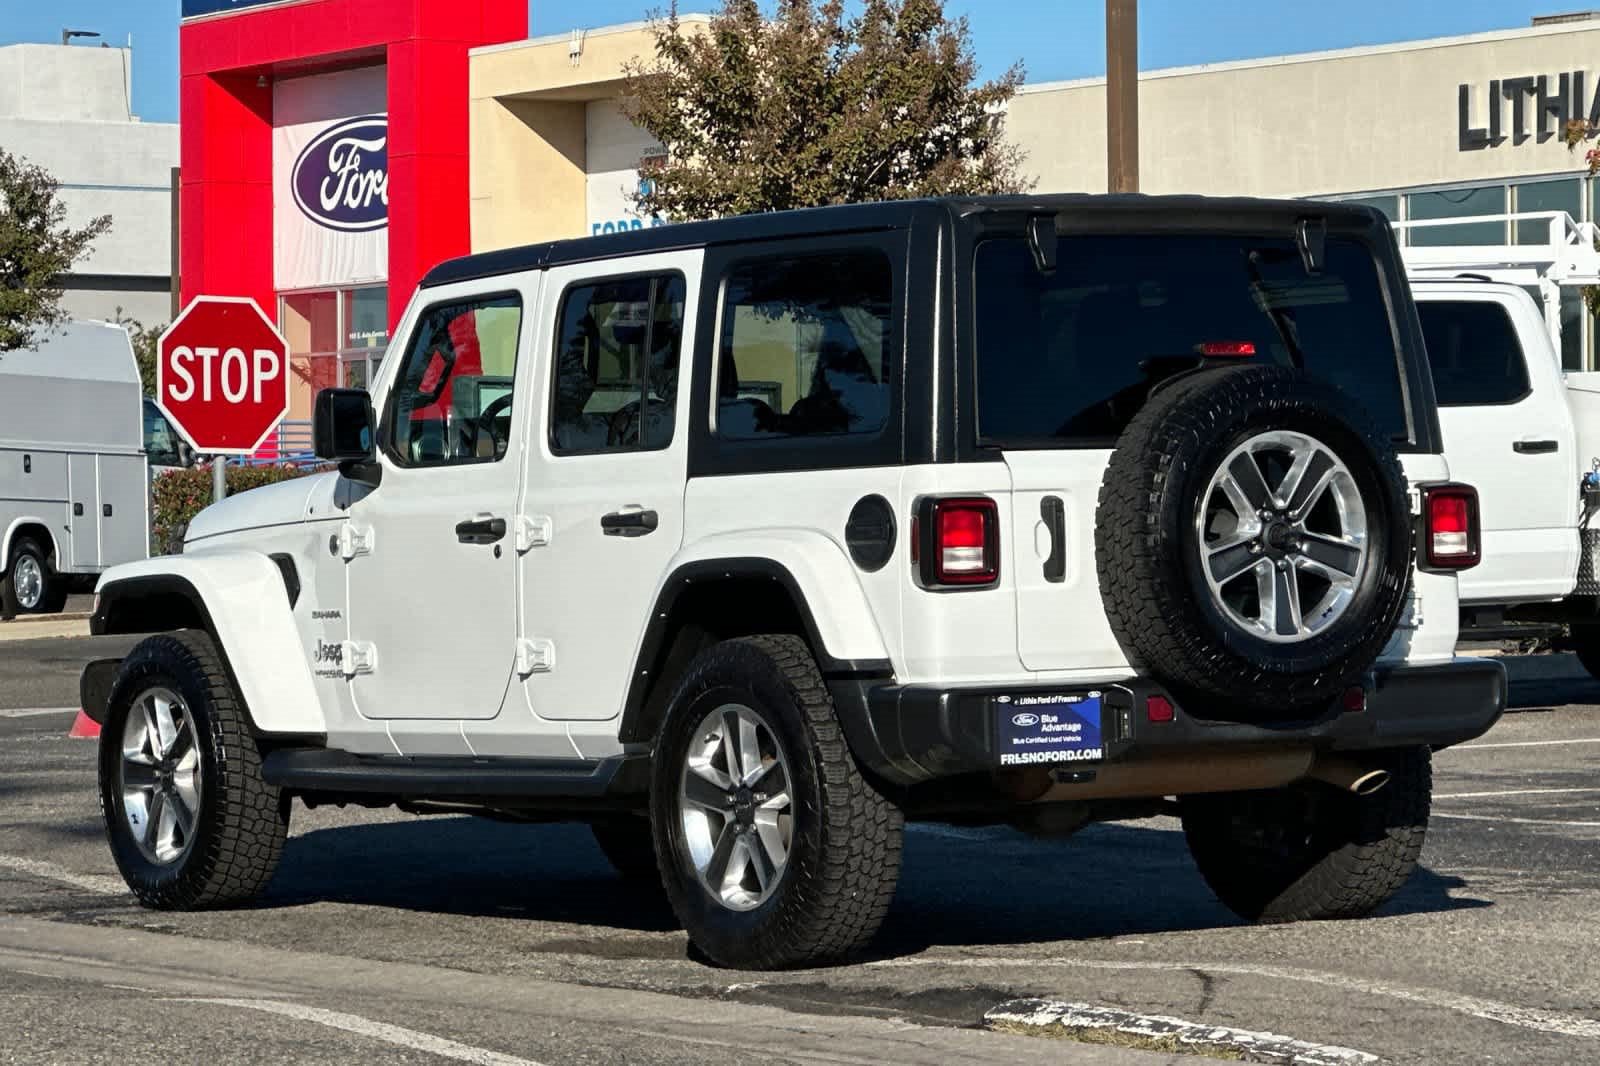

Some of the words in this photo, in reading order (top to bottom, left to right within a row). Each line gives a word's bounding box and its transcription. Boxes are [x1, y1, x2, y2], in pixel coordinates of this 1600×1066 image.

[168, 345, 280, 404] STOP
[313, 639, 343, 666] Jeep
[1020, 697, 1037, 705] Lithia
[1037, 696, 1051, 704] Ford
[1051, 695, 1058, 704] of
[1058, 695, 1078, 703] Fresno
[1040, 714, 1059, 723] Blue
[1041, 723, 1082, 732] Advantage
[1025, 736, 1048, 744] Certified
[1000, 748, 1102, 765] FRESNOFORD.COM
